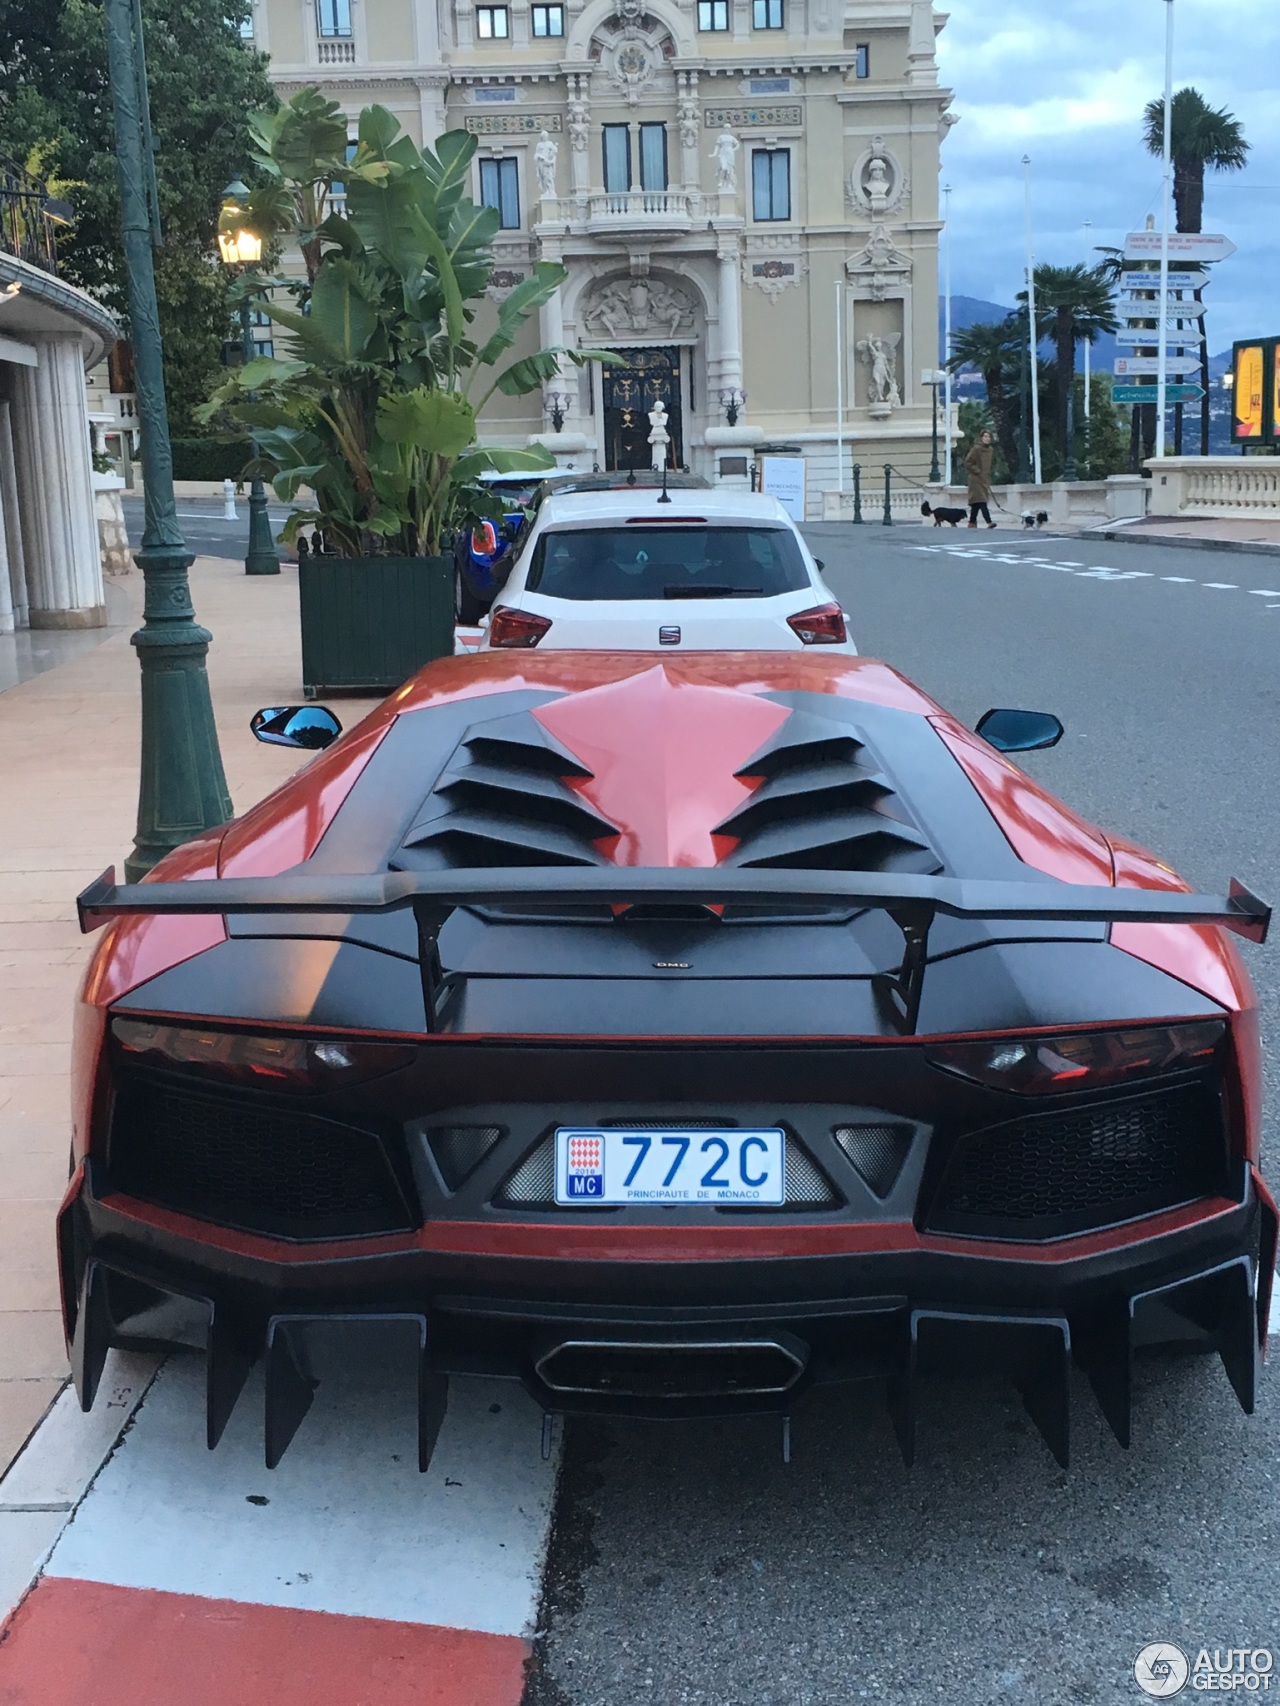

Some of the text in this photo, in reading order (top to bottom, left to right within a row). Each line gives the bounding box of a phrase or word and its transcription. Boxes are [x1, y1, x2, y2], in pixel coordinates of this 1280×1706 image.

[622, 1136, 769, 1188] 772C
[574, 1176, 597, 1194] MC
[627, 1189, 760, 1199] PRINCIPAUTE DE MONACO
